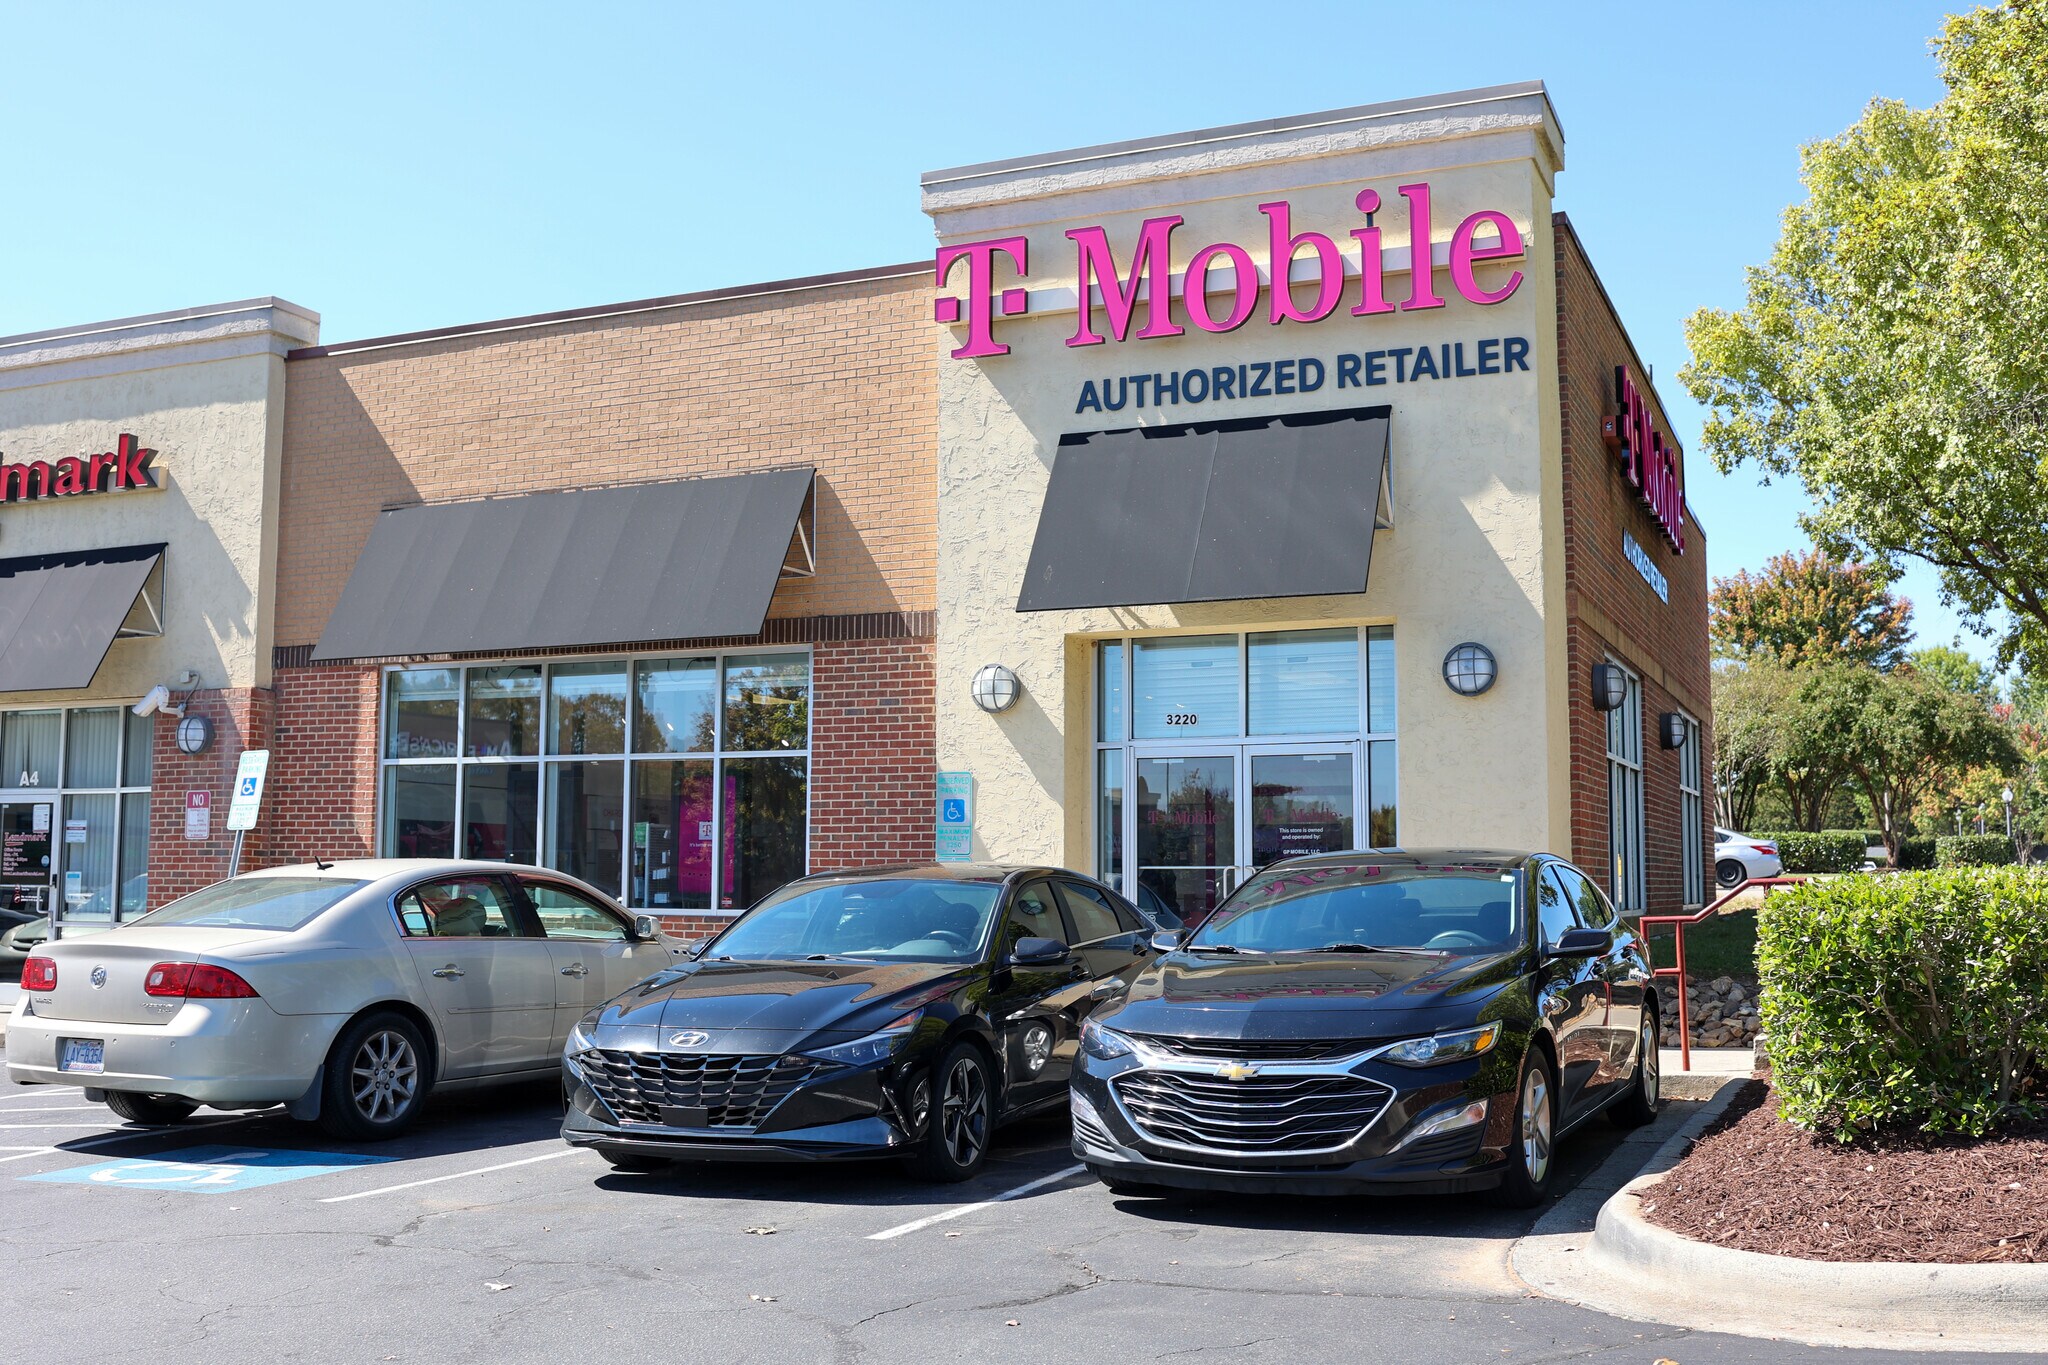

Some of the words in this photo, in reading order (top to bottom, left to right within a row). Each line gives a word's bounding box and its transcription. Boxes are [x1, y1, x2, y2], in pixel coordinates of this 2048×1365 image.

[1065, 182, 1525, 348] Mobile
[1075, 357, 1326, 414] AUTHORIZED
[1337, 336, 1531, 389] RETAILER
[0, 433, 158, 503] mark
[1166, 714, 1198, 725] 3220
[19, 771, 39, 786] A4
[940, 786, 968, 794] PARKING
[192, 794, 204, 806] NO
[1174, 810, 1221, 825] Mobile
